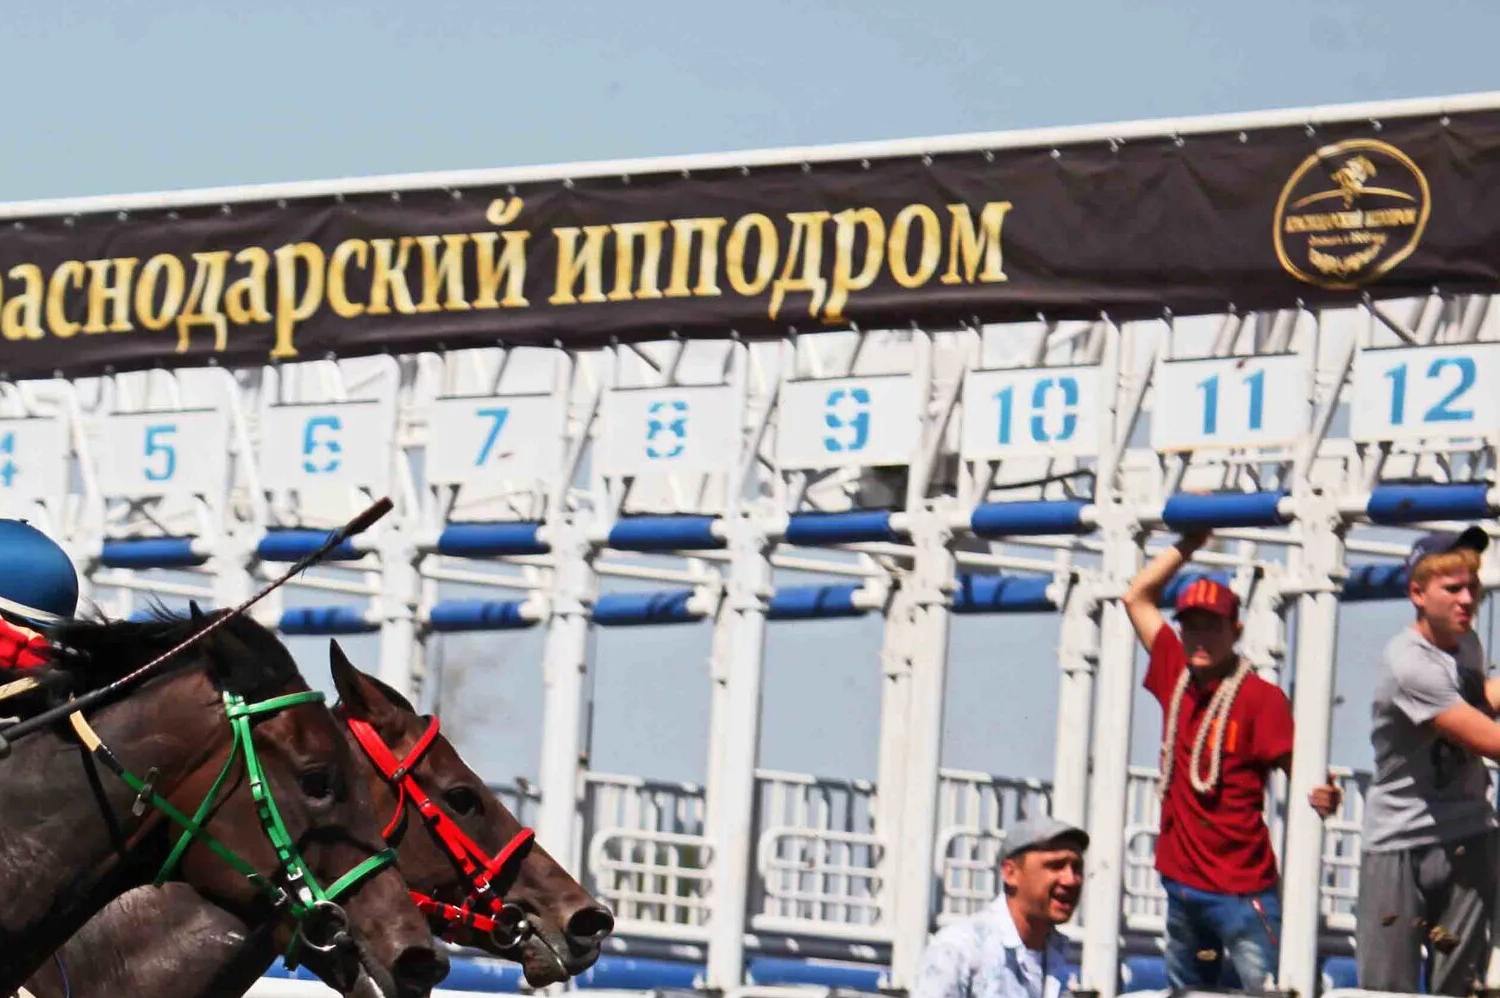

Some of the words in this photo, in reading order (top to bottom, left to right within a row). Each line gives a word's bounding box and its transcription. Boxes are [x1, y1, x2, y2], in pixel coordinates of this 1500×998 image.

[547, 200, 1013, 324] ипподром
[823, 387, 871, 453] 9
[994, 376, 1080, 445] 10
[1197, 369, 1266, 435] 11
[1384, 355, 1478, 427] 12
[143, 424, 177, 482] 5
[302, 415, 342, 475] 6
[474, 406, 510, 466] 7
[645, 400, 688, 459] 8
